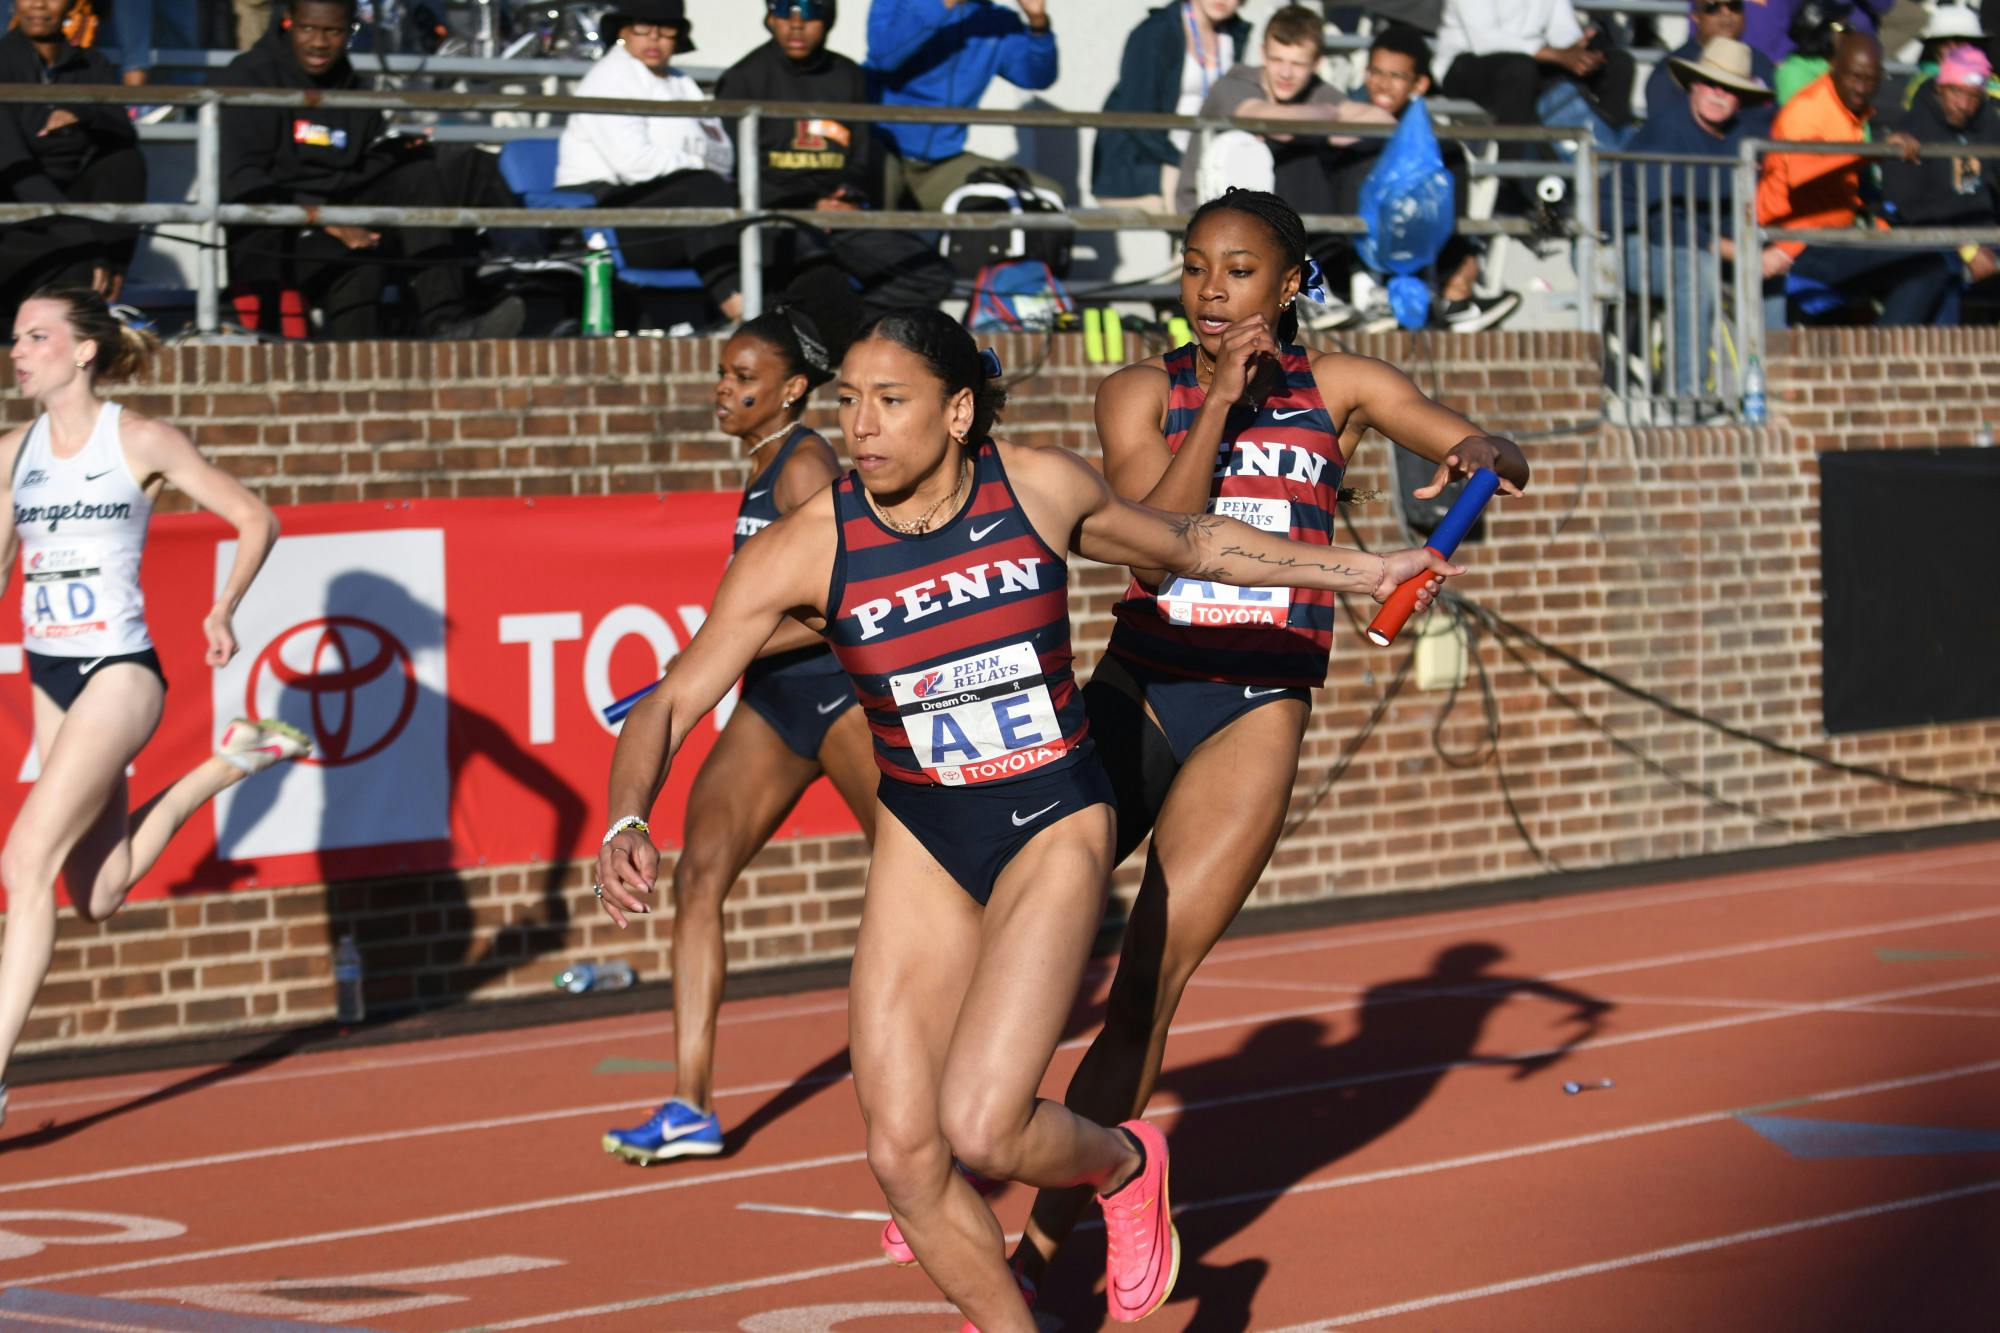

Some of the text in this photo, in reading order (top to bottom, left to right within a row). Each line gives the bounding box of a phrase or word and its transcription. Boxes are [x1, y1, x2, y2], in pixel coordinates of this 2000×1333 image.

[15, 500, 131, 532] eorgetown
[1222, 501, 1263, 514] PENN
[850, 557, 1041, 641] PENN
[1196, 607, 1274, 625] TOYOTA
[952, 655, 1001, 678] PENN
[953, 664, 1019, 689] RELAYS
[922, 692, 981, 712] Dream On.
[965, 748, 1054, 780] TOYOTA
